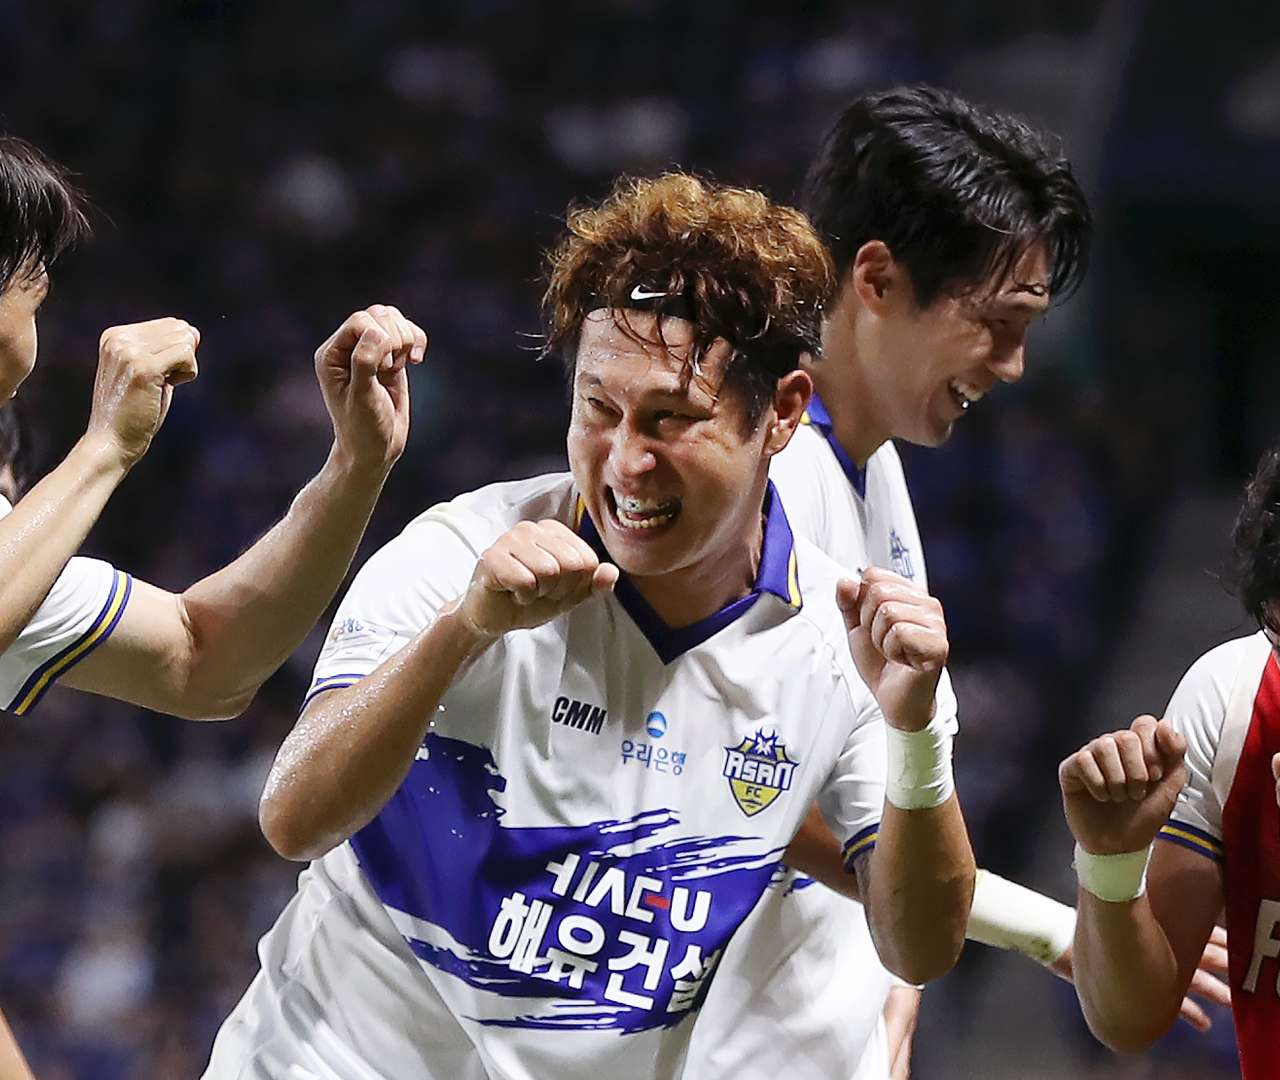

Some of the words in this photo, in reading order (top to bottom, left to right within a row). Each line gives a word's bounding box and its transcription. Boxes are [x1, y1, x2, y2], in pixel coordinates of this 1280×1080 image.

[620, 739, 687, 776] 우리은행
[724, 749, 797, 790] ASAN
[745, 785, 763, 798] FC
